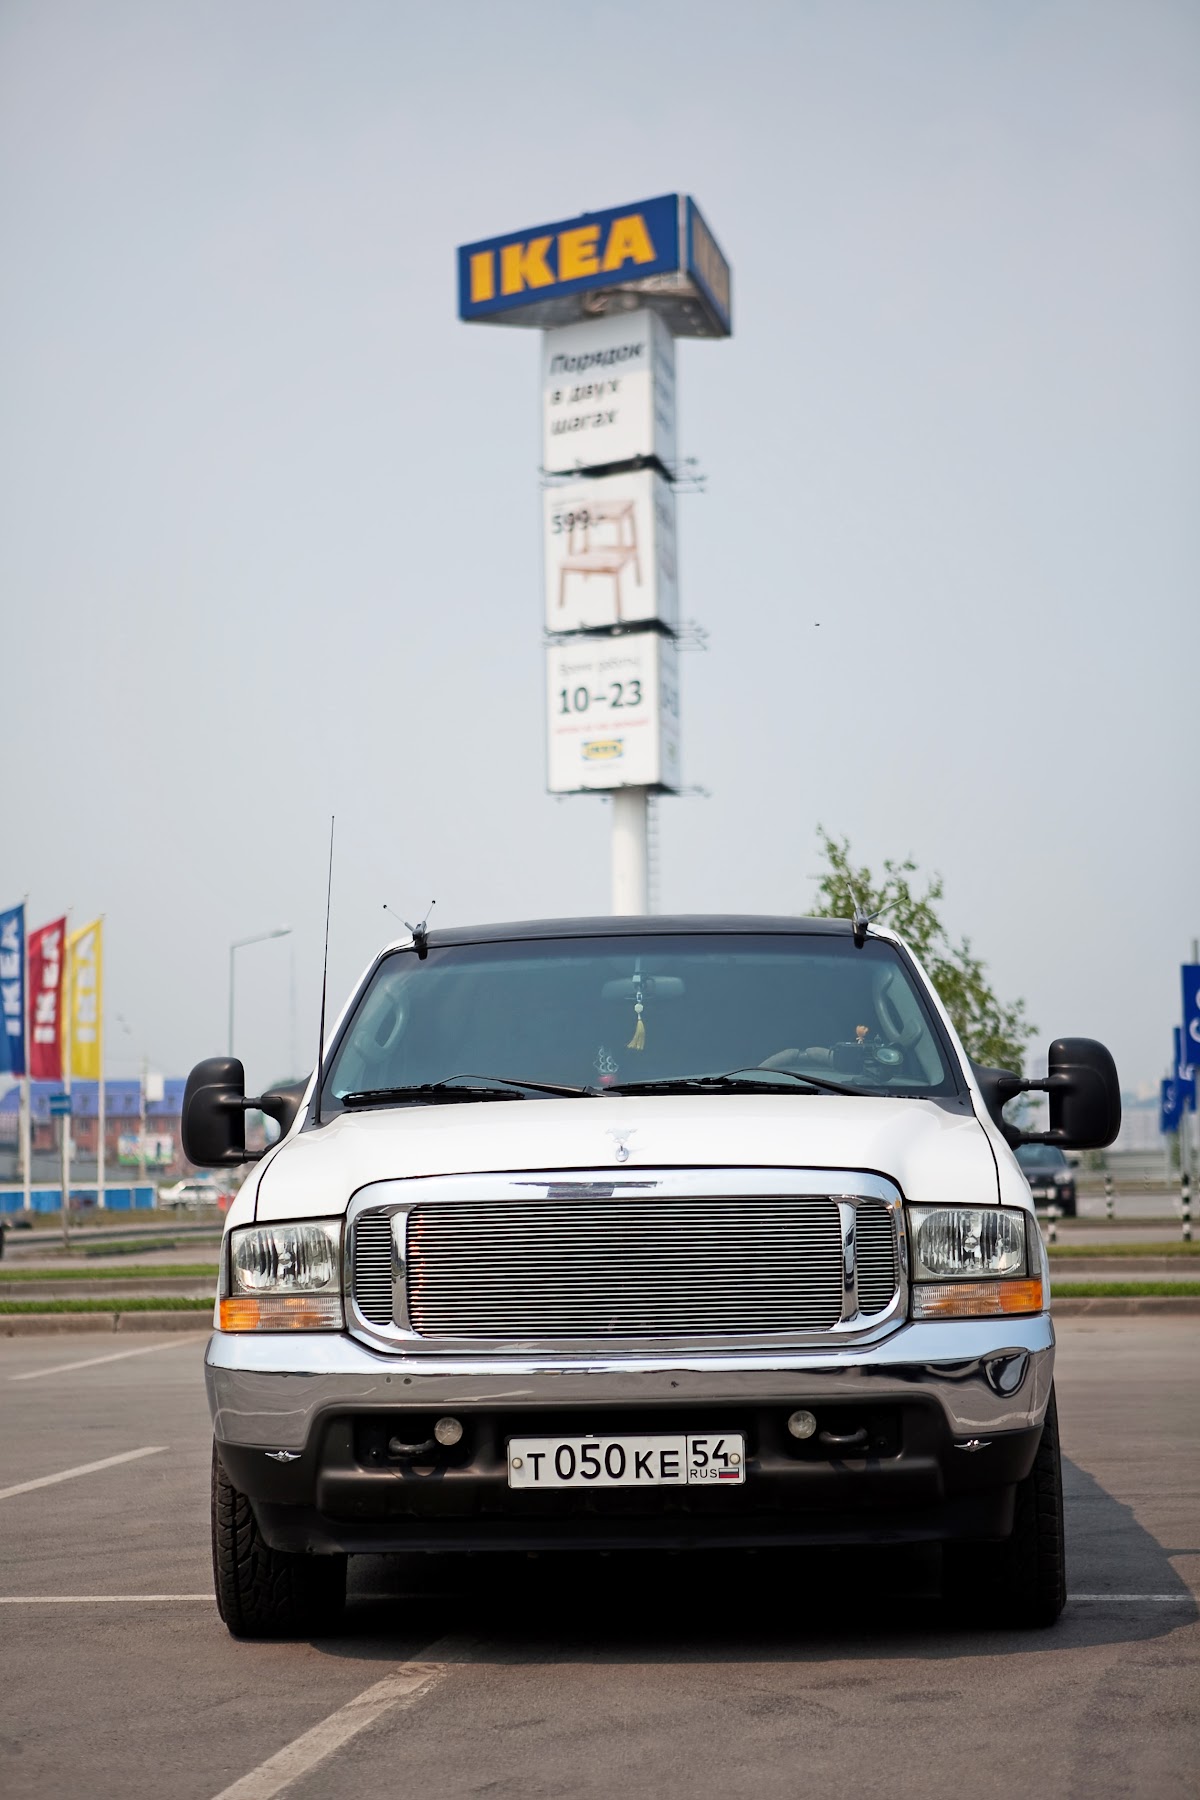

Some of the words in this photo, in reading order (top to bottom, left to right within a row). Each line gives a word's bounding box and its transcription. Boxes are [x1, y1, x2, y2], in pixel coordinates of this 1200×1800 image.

[470, 214, 656, 303] IKEA
[549, 342, 645, 375] Порядок
[551, 410, 619, 435] шагах
[0, 917, 21, 1037] IKEA
[34, 929, 61, 1044] IKEA
[692, 1439, 729, 1467] 54
[690, 1468, 718, 1479] RUS
